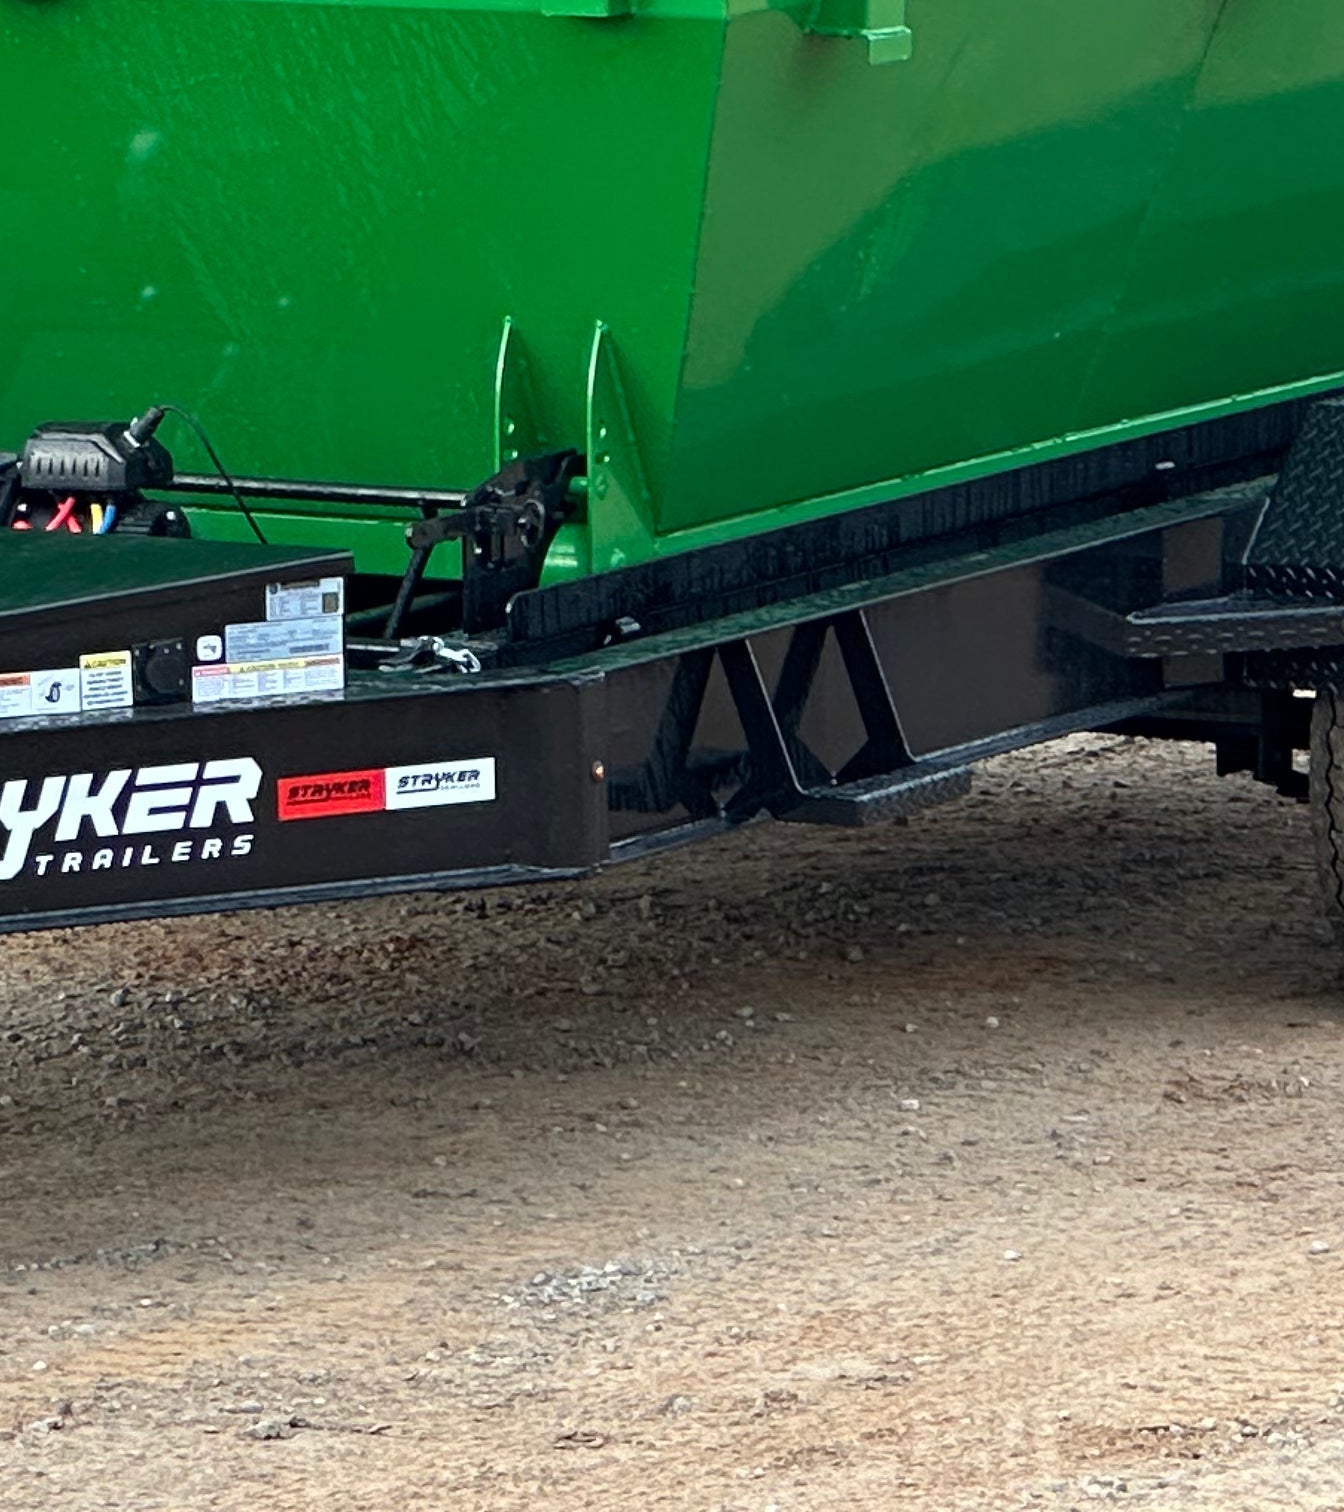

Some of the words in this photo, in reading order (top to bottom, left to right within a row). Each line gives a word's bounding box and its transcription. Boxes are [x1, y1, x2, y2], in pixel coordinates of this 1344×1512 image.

[286, 778, 371, 805] STRYKER
[396, 769, 480, 795] STRYKER
[35, 834, 255, 876] TRAILERS
